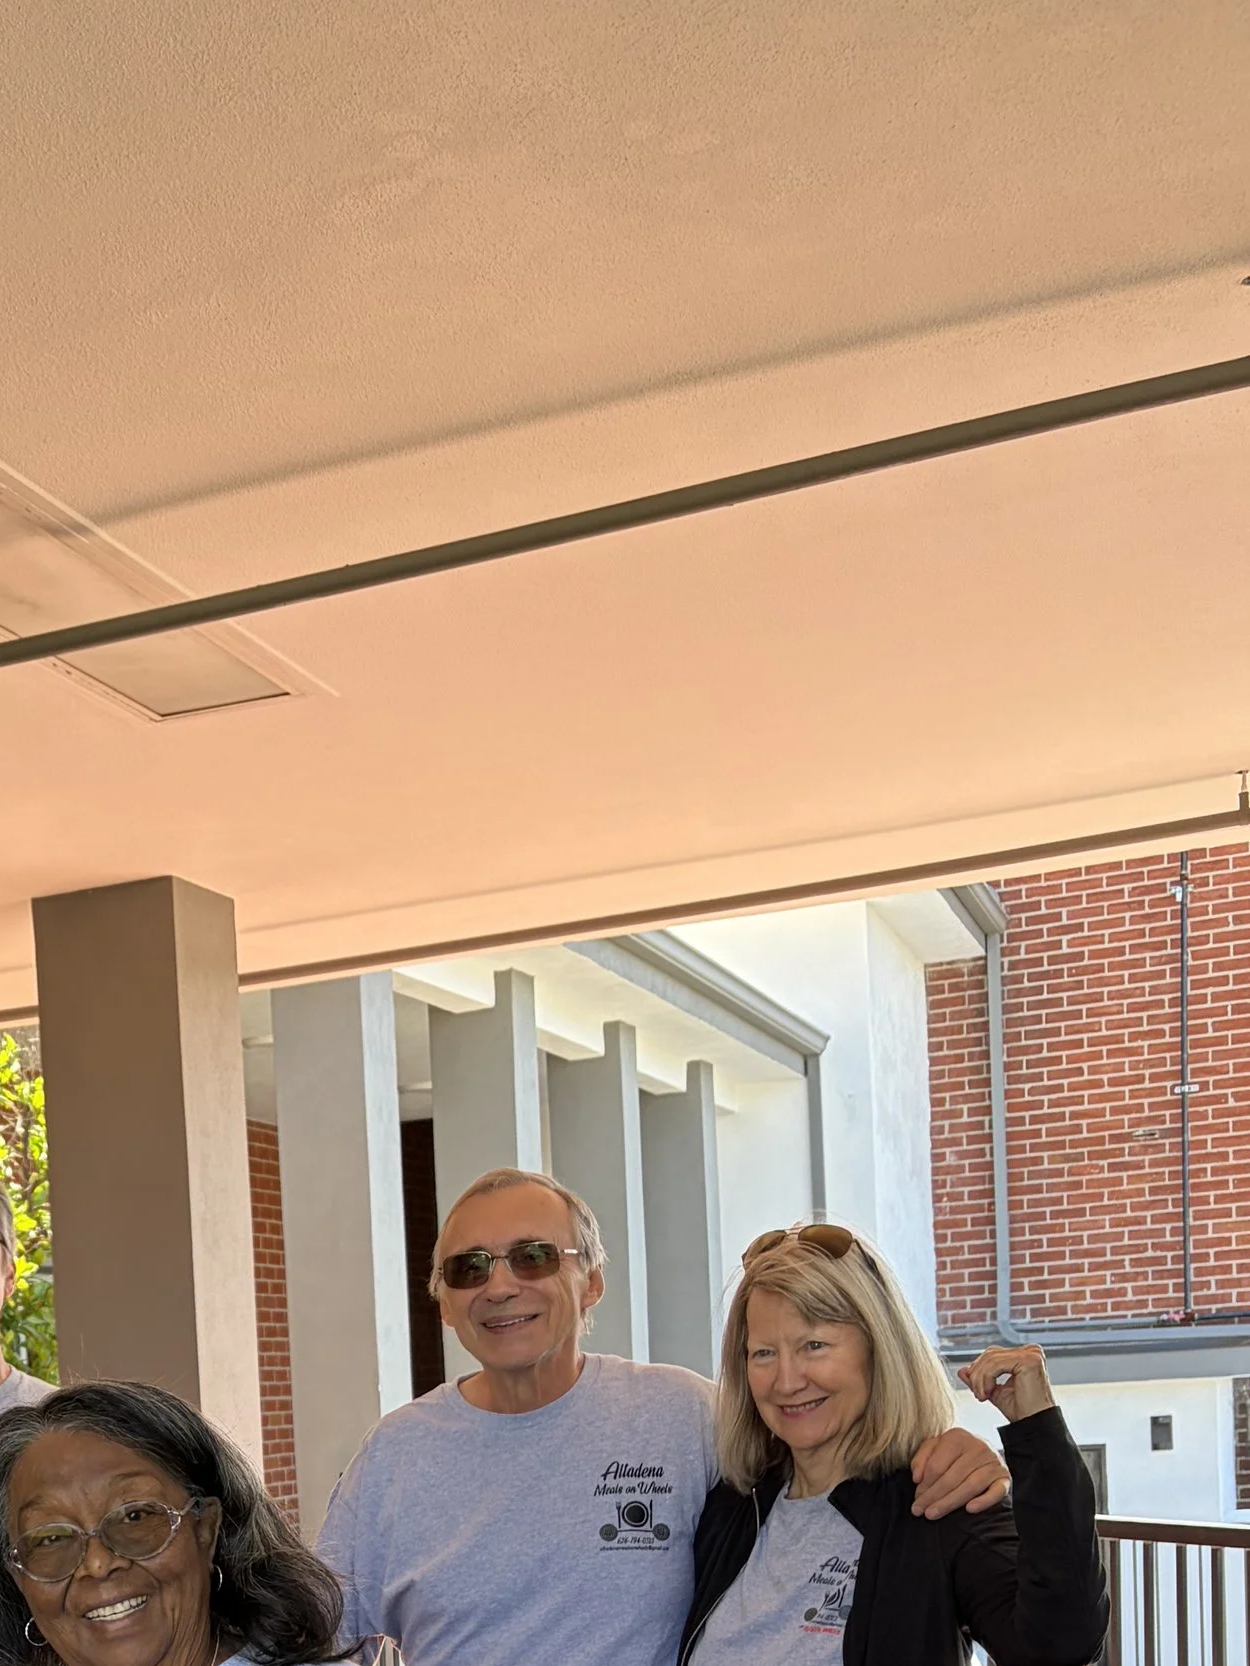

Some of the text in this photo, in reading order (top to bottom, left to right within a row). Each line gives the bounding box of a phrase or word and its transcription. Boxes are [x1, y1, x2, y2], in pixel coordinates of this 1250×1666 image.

[601, 1460, 665, 1481] Altadena
[593, 1481, 673, 1496] Meals on Wheels
